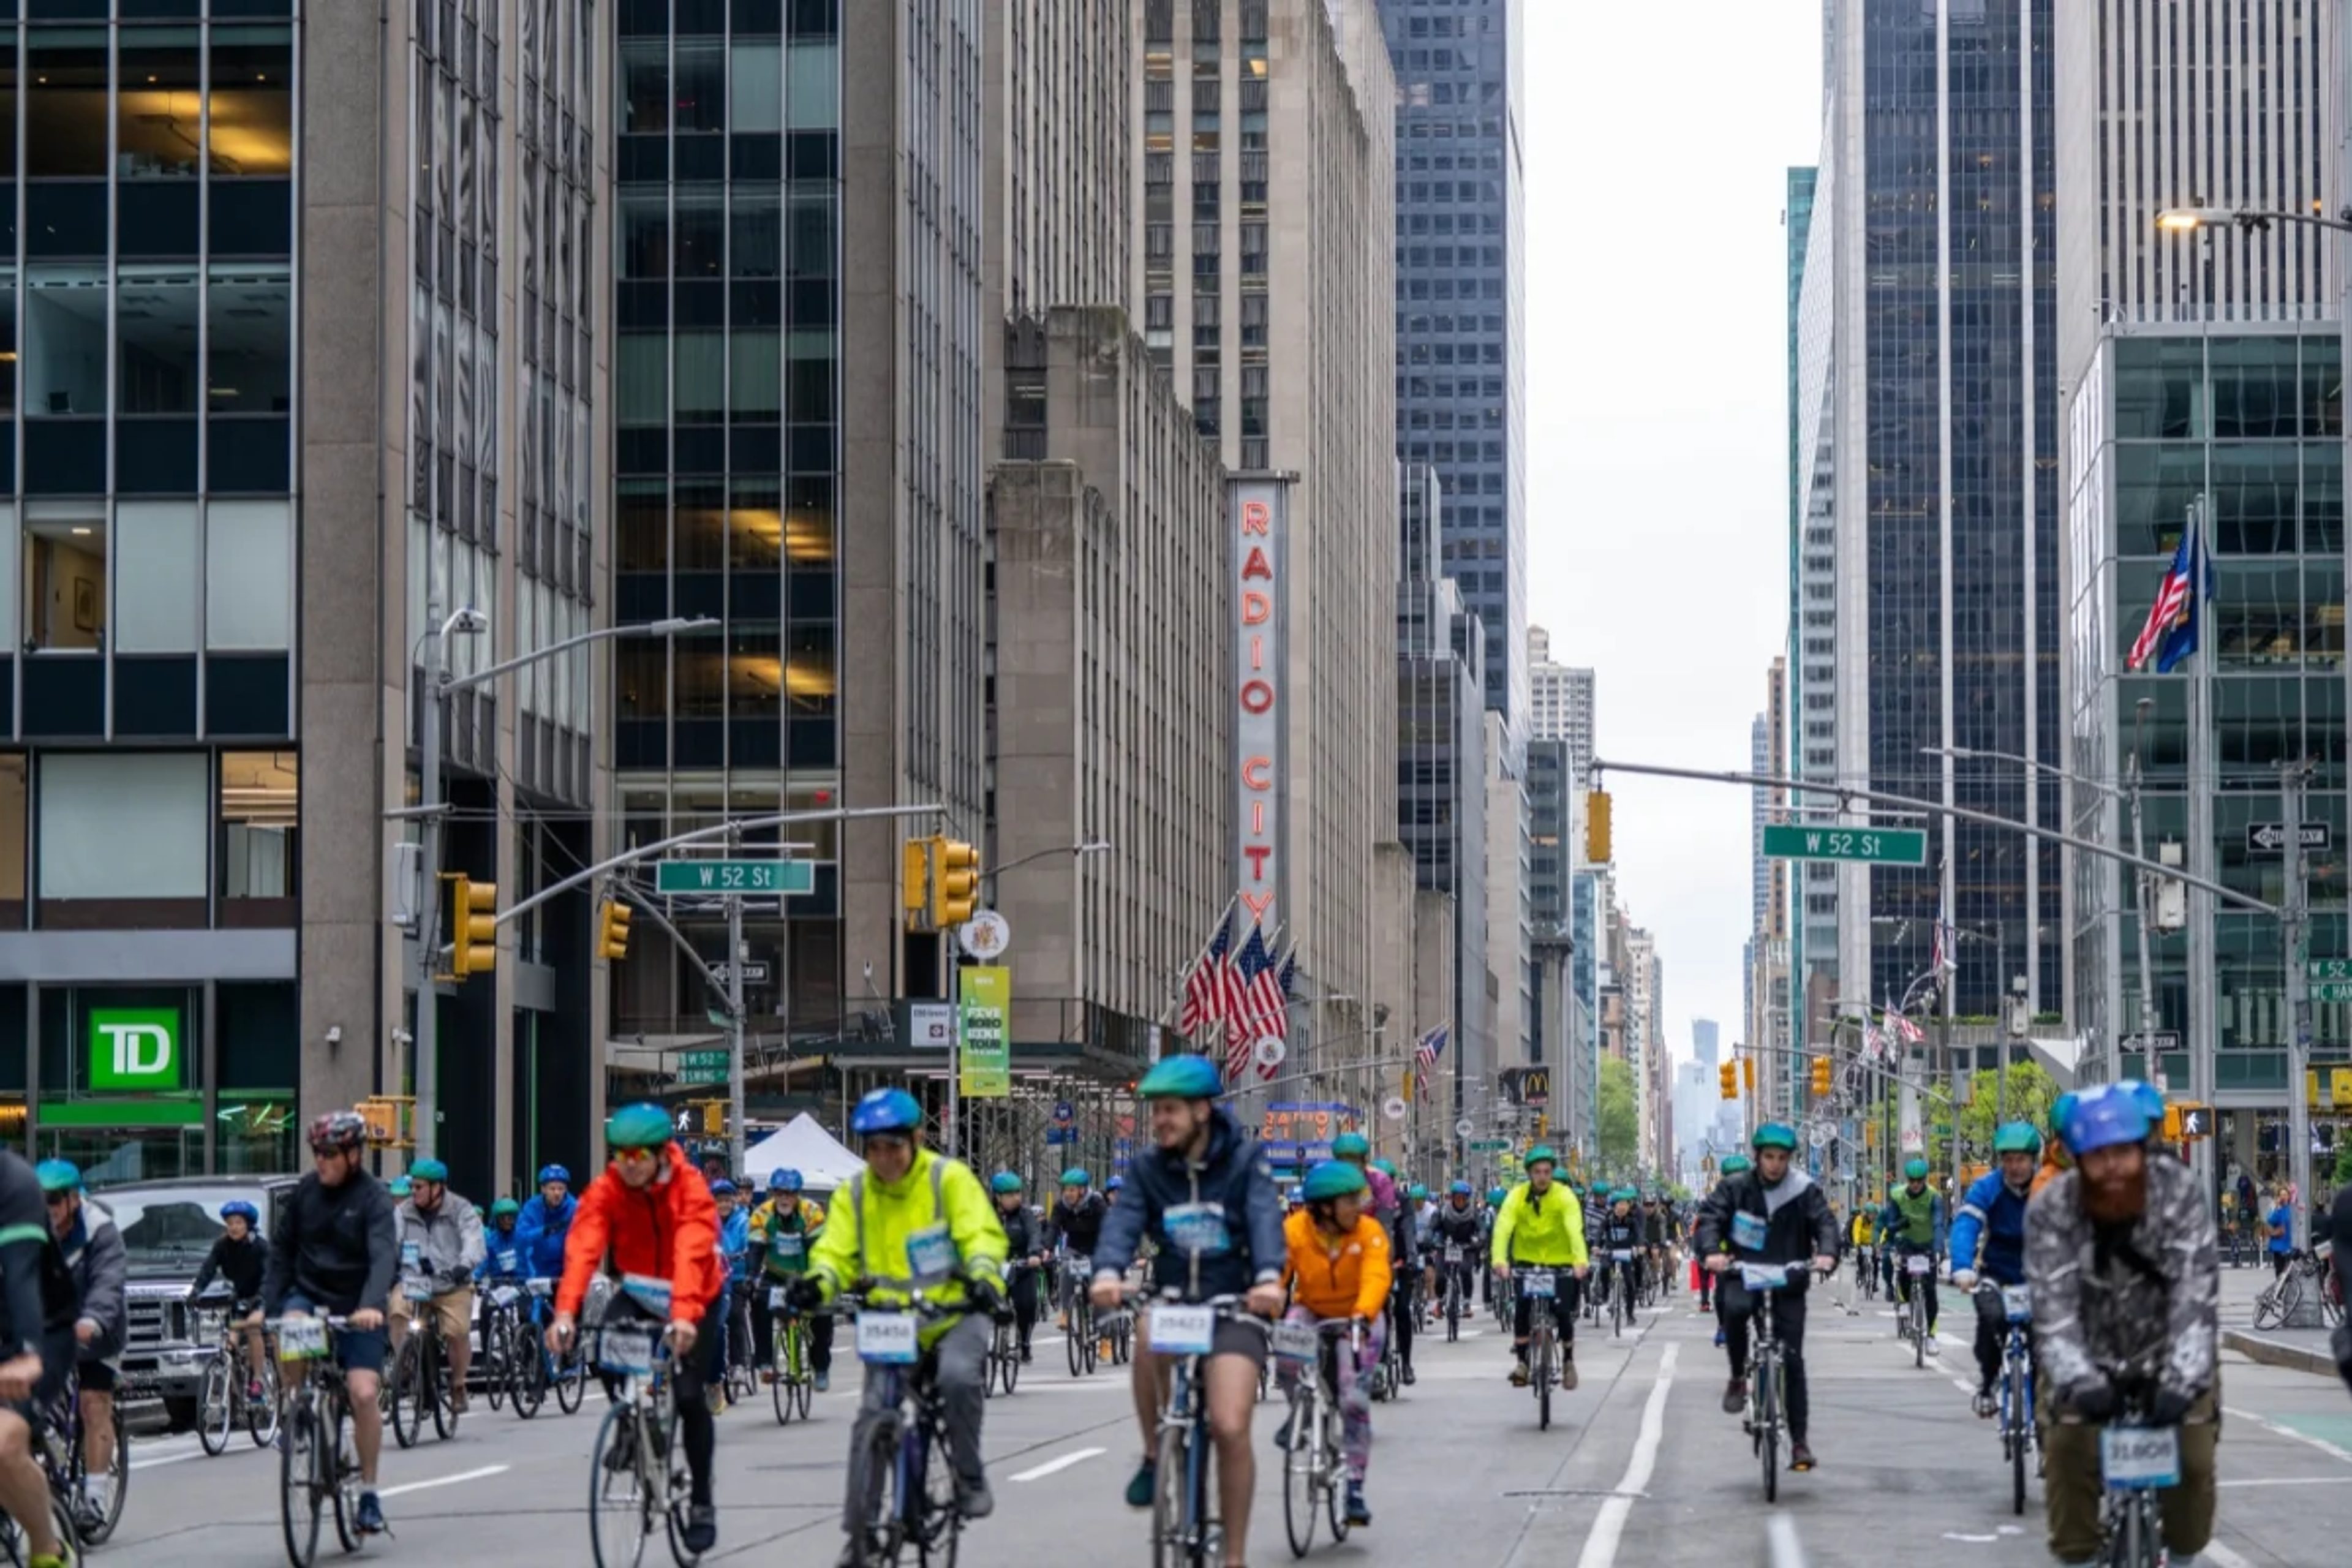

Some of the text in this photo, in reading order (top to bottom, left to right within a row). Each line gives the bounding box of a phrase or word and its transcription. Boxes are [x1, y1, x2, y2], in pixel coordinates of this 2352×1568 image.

[1240, 500, 1274, 925] RADIO CITY
[1806, 831, 1881, 856] W 52 St
[699, 866, 771, 887] W 52 St
[2309, 961, 2345, 978] W 52
[98, 1023, 171, 1075] TD
[968, 1039, 1001, 1050] TOUR
[699, 1052, 714, 1065] 52
